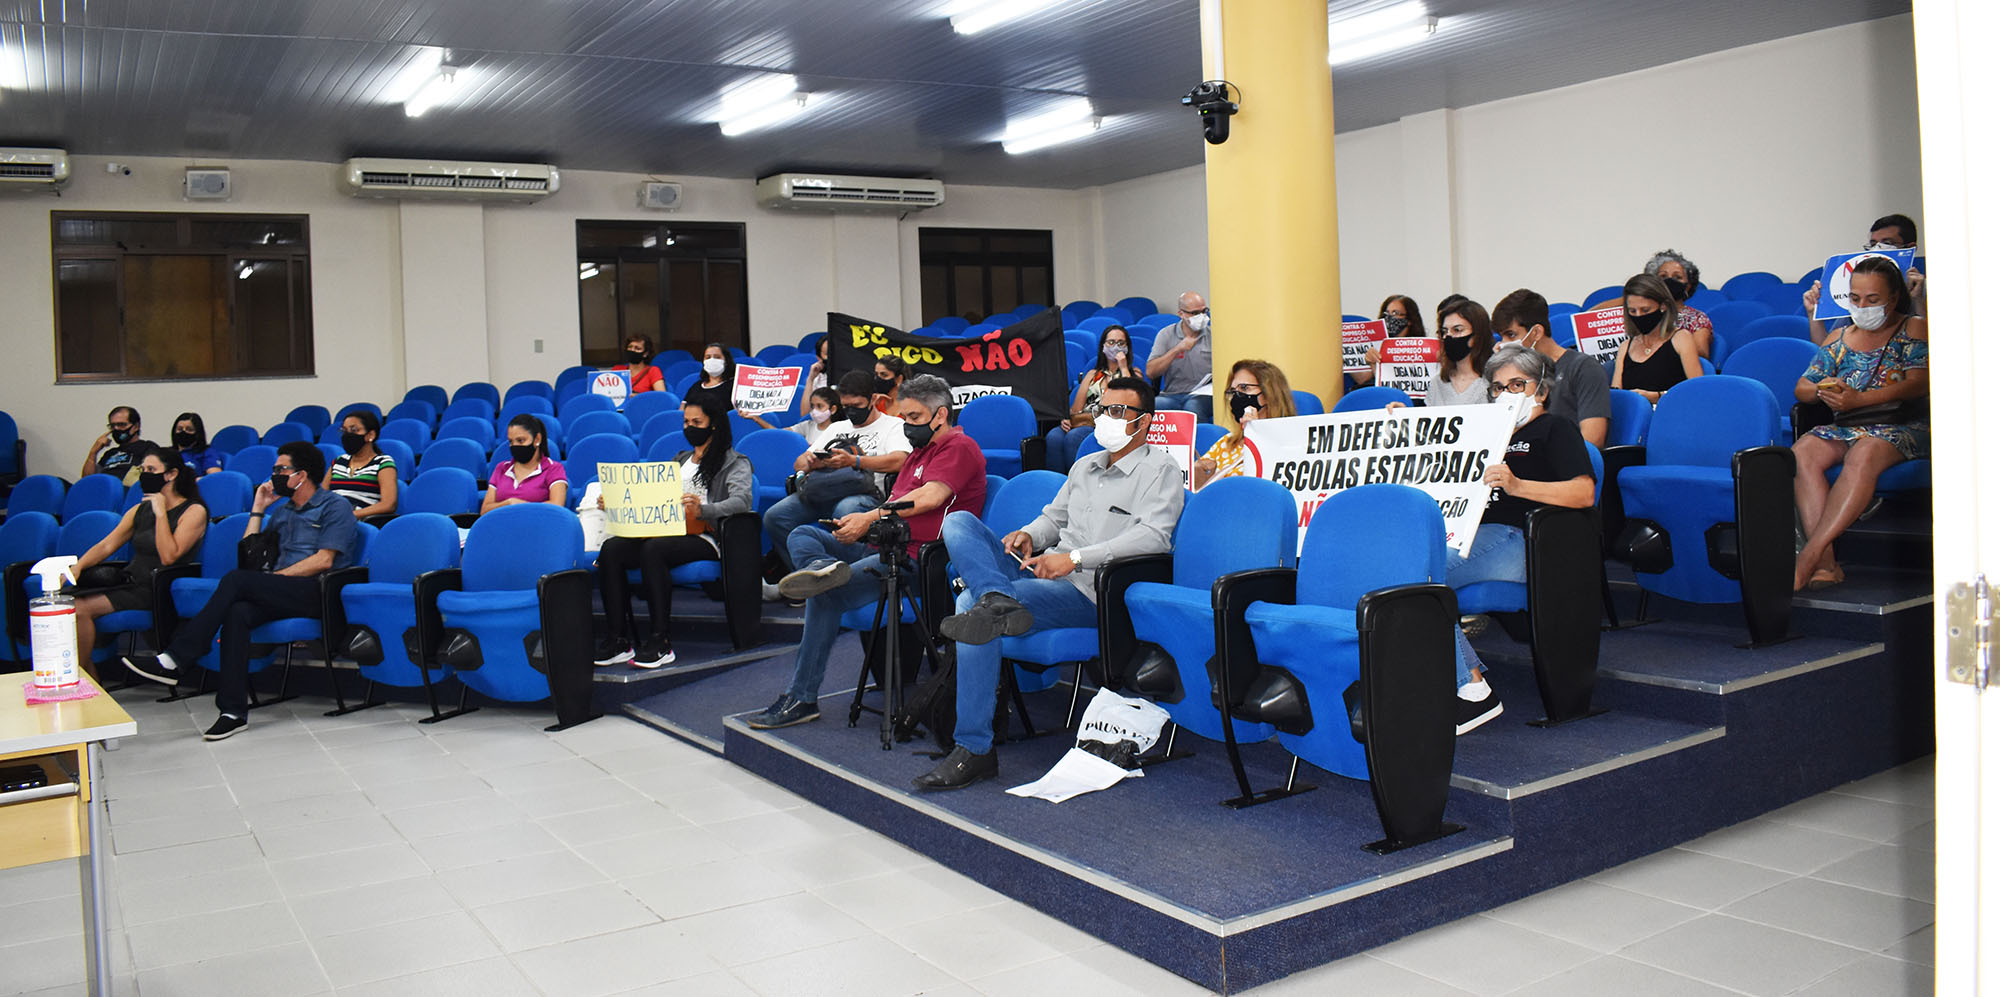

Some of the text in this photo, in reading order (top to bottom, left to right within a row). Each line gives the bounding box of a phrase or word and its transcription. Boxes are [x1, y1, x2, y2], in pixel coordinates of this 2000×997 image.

[849, 324, 888, 348] EU
[1597, 338, 1618, 350] DIGA
[955, 329, 1033, 372] NÃO
[597, 373, 620, 387] NÃO
[1393, 366, 1409, 378] DIGA
[1409, 364, 1423, 378] NÃO
[1166, 423, 1178, 432] NA
[1307, 416, 1463, 454] EM DEFESA DAS
[600, 464, 676, 485] SOU CONTRA
[1272, 449, 1489, 491] ESCOLAS ESTADUAIS
[623, 488, 632, 504] A
